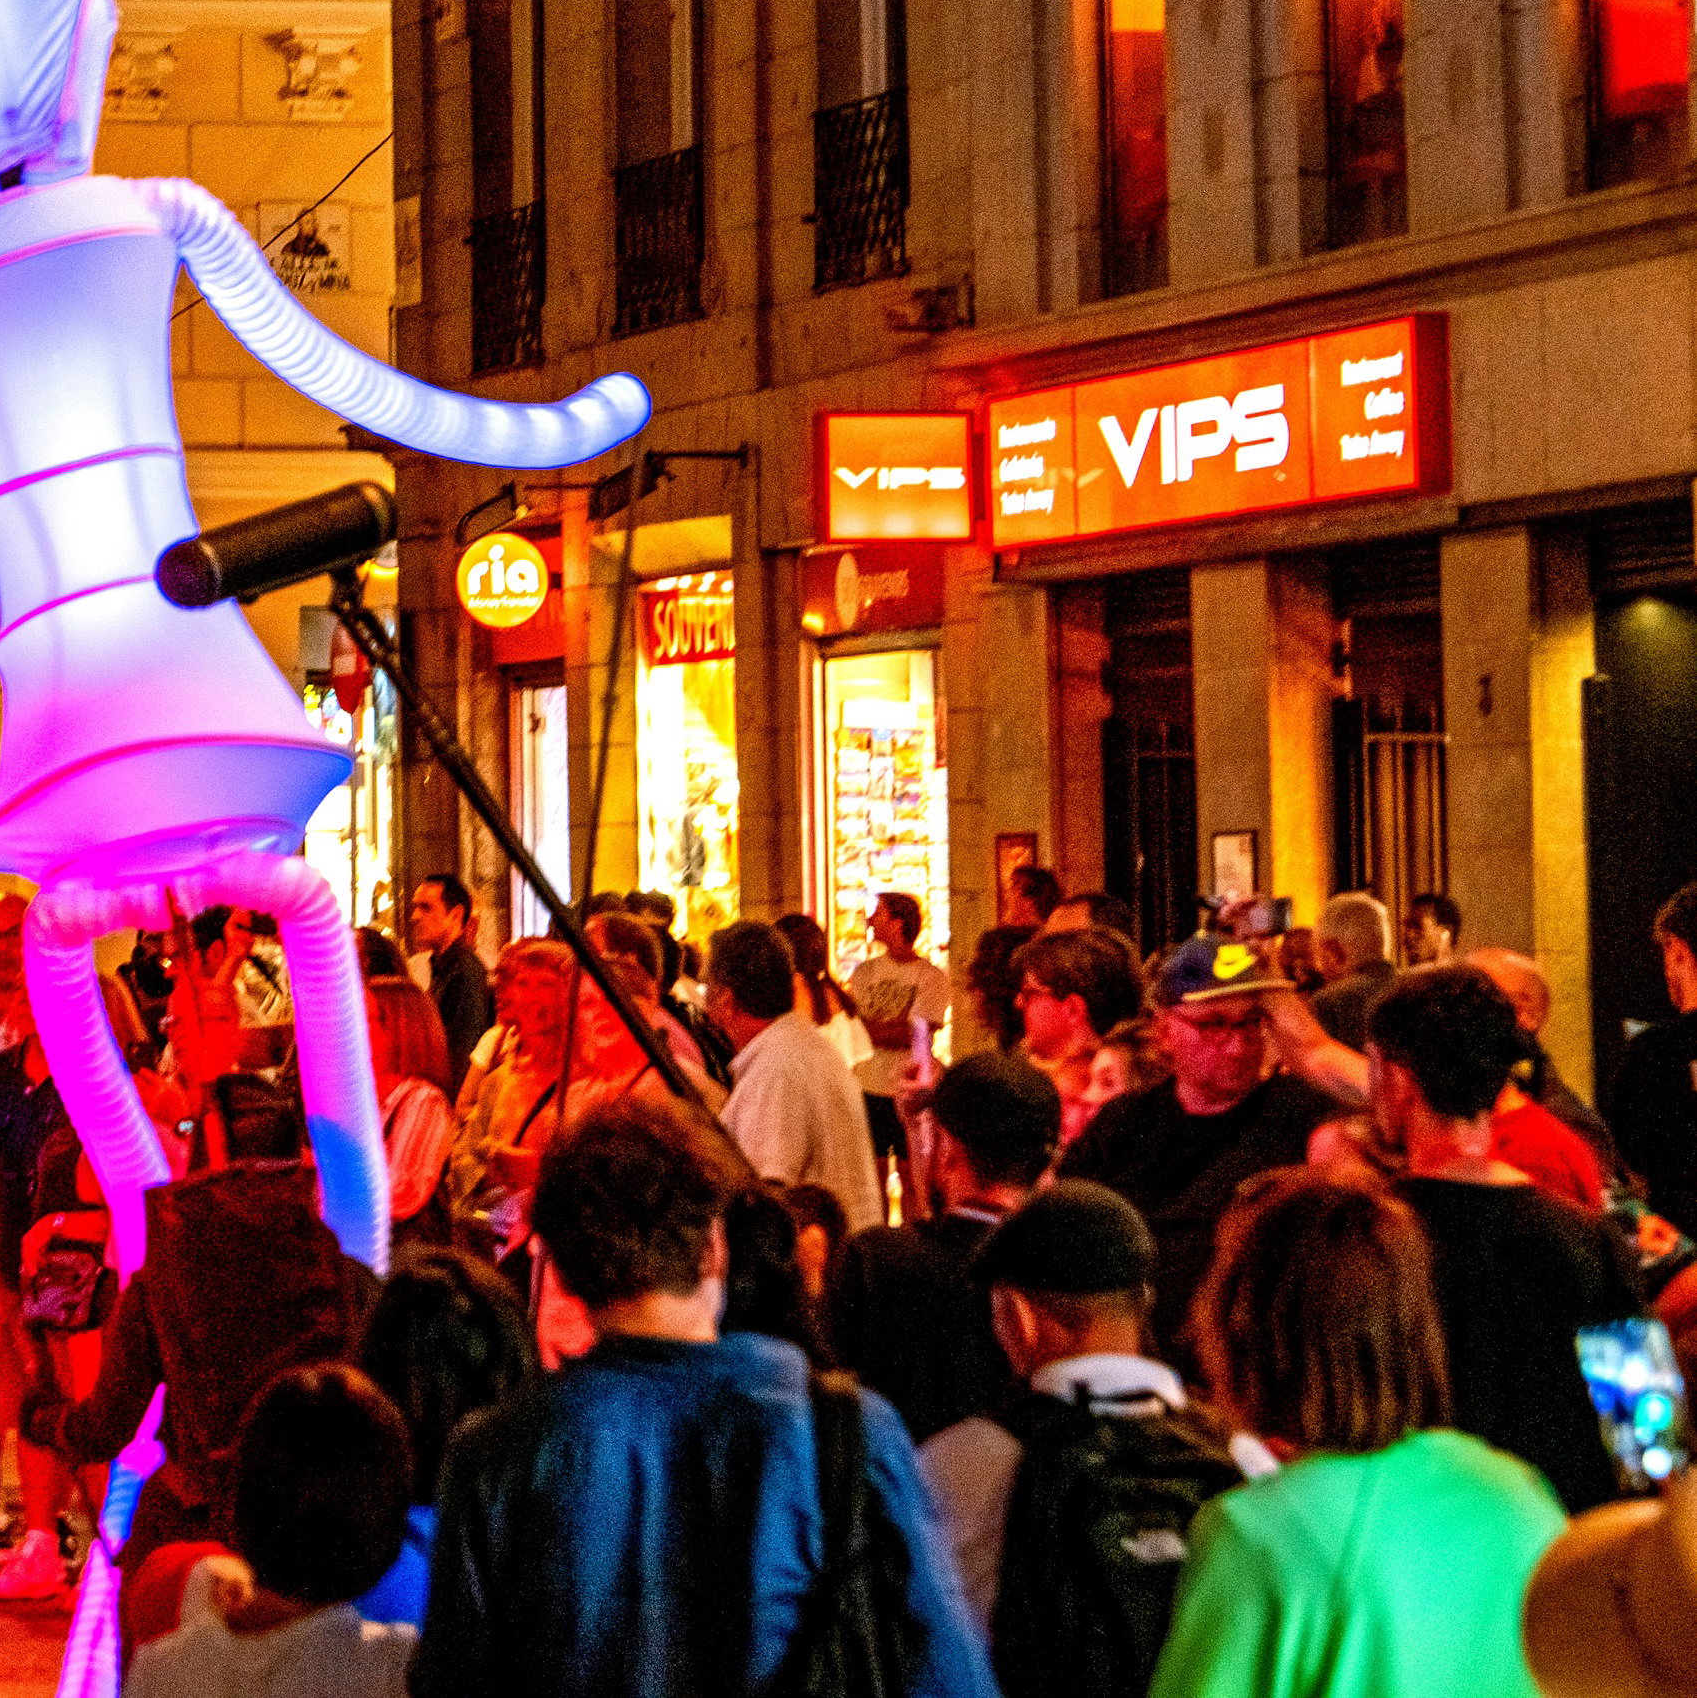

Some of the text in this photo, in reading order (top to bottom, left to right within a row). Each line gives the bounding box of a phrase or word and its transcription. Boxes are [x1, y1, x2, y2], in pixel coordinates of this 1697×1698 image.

[1097, 383, 1290, 489] VIPS
[833, 466, 966, 490] VIPS
[467, 543, 540, 595] ria
